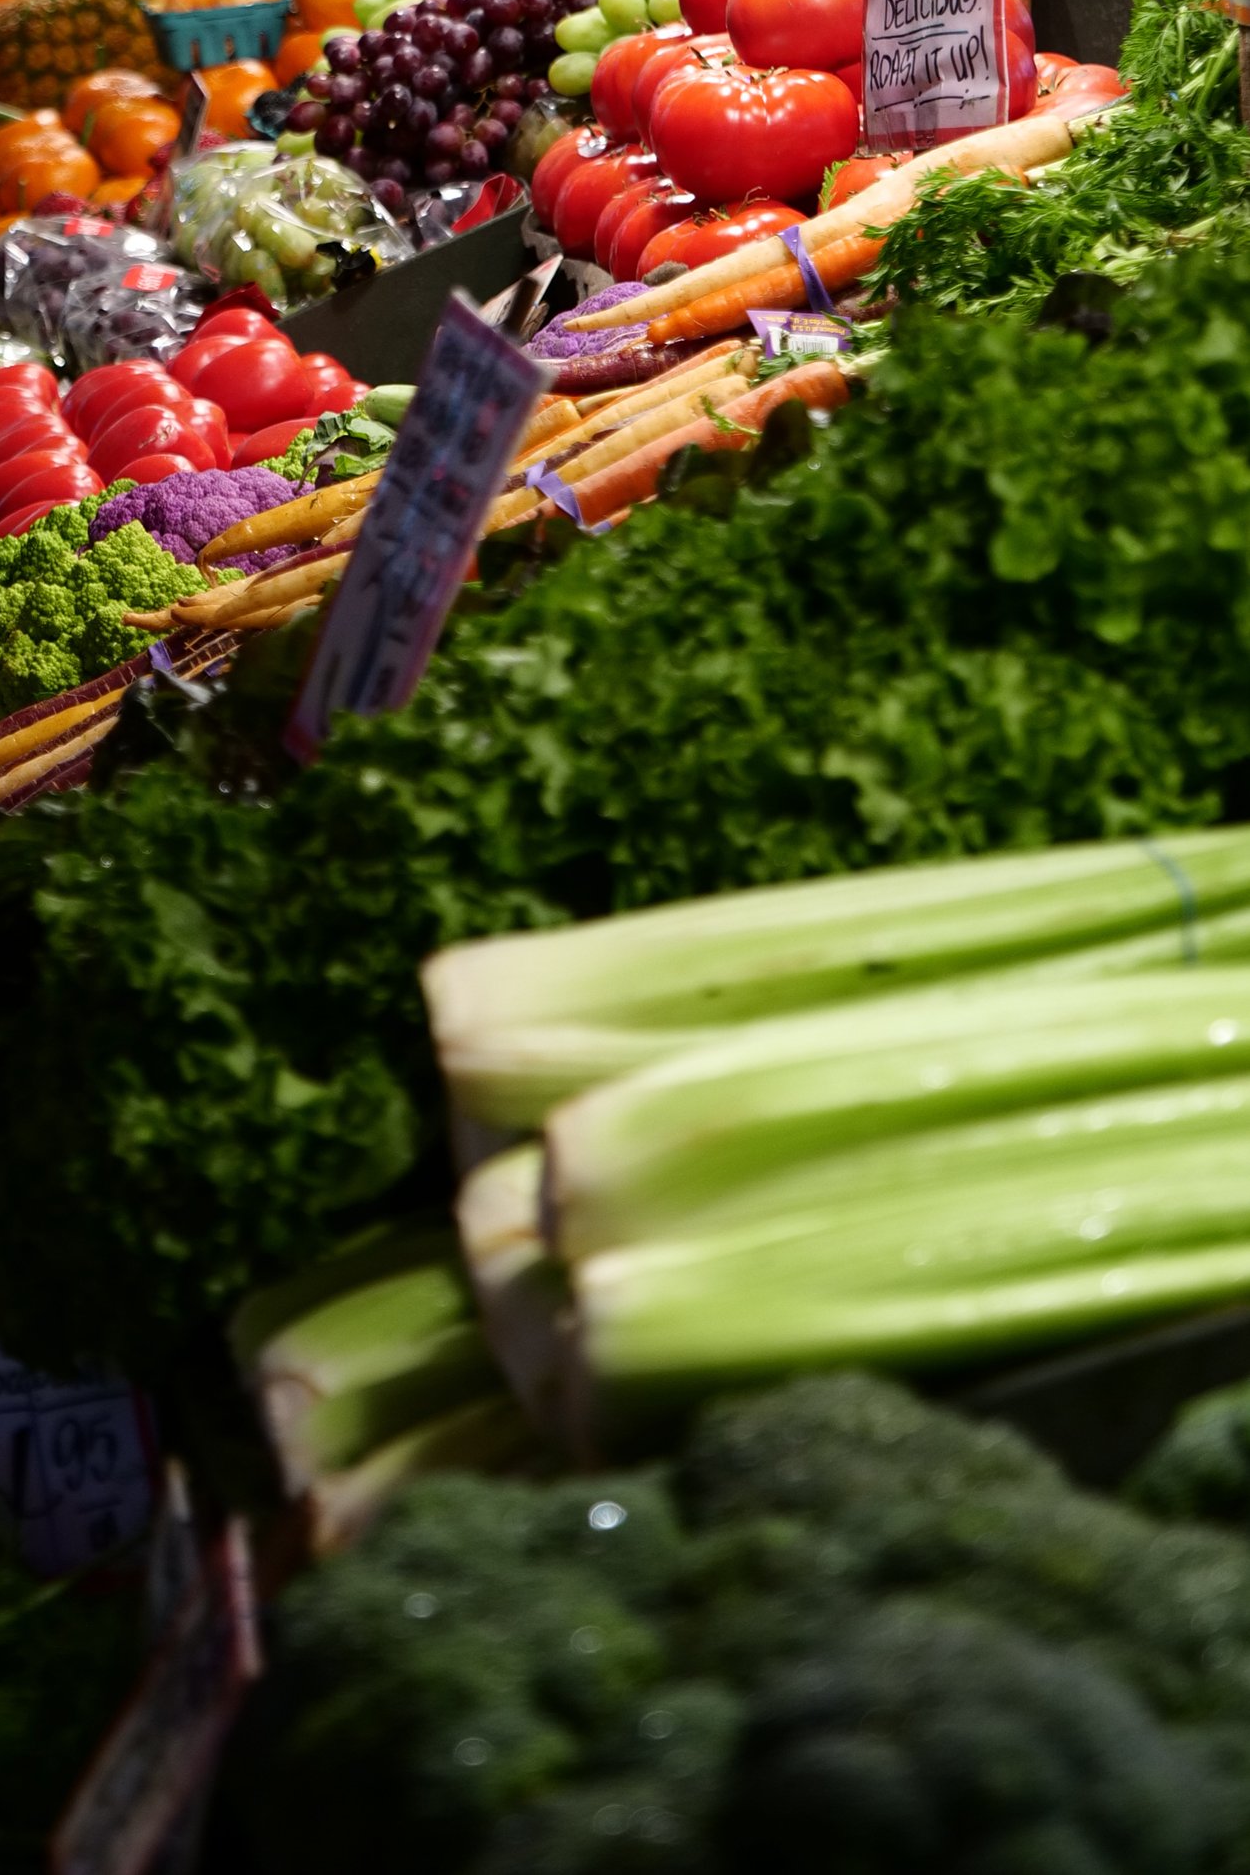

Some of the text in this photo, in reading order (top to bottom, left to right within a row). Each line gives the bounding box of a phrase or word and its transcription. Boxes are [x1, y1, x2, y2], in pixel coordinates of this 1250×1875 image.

[870, 23, 990, 93] ROAST IT UP!
